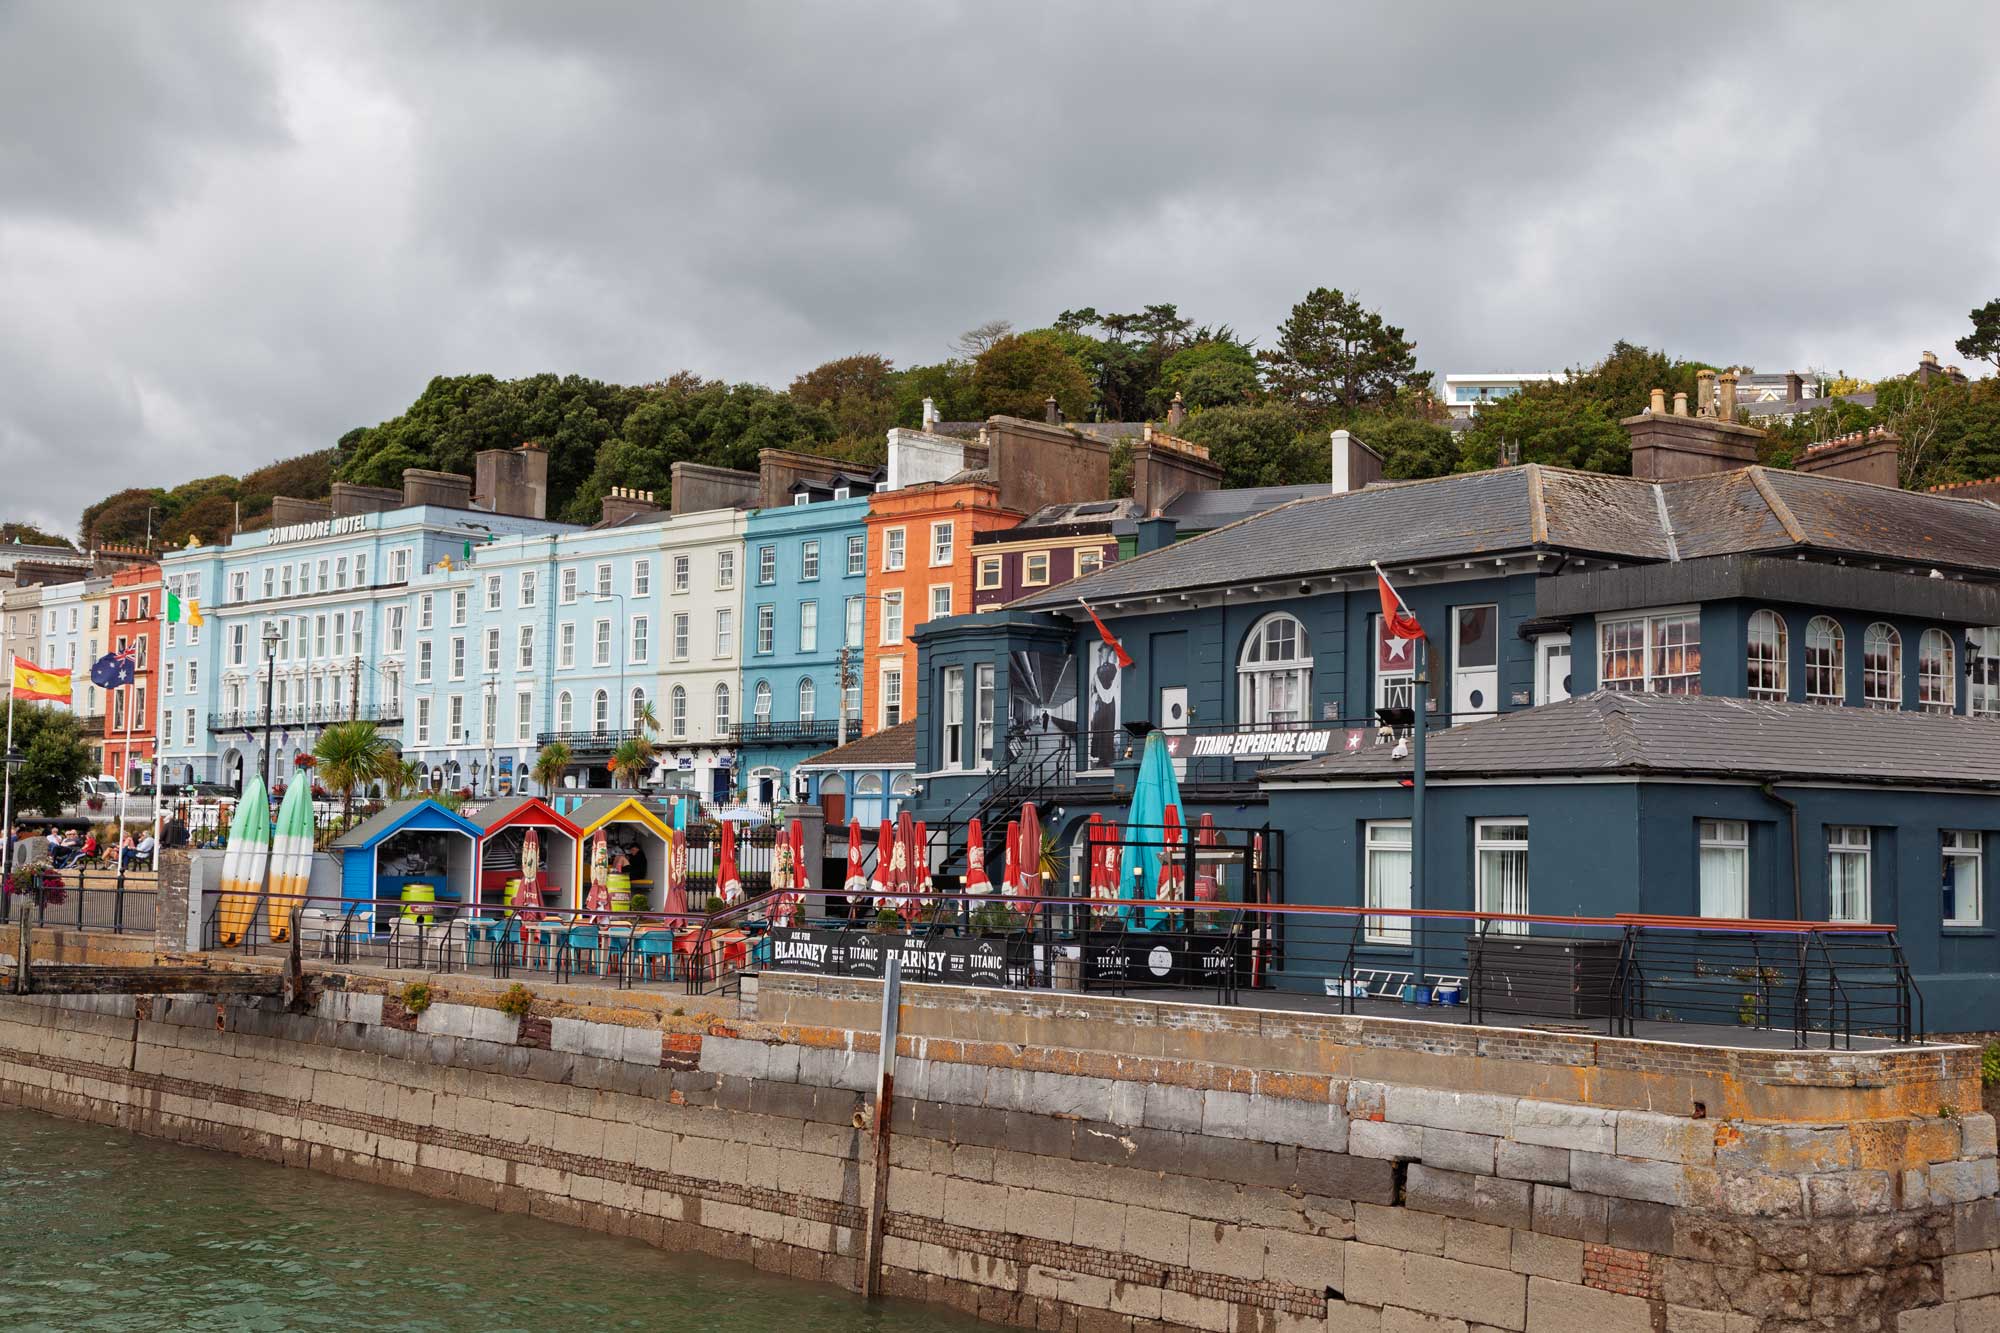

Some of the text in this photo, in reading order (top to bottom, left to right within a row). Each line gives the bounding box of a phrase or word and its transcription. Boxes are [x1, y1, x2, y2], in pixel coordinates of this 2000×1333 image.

[267, 515, 367, 544] COMMODORE HOTEL
[1193, 731, 1331, 755] TITANIC EXPERIENCE COBH
[679, 757, 692, 765] DNG
[791, 932, 811, 941] ASK FOR
[904, 939, 915, 948] ASK
[774, 941, 828, 963] BLARNEY
[849, 947, 879, 961] TITANIC
[970, 954, 1003, 970] TITANIC
[1096, 956, 1130, 968] TITANC
